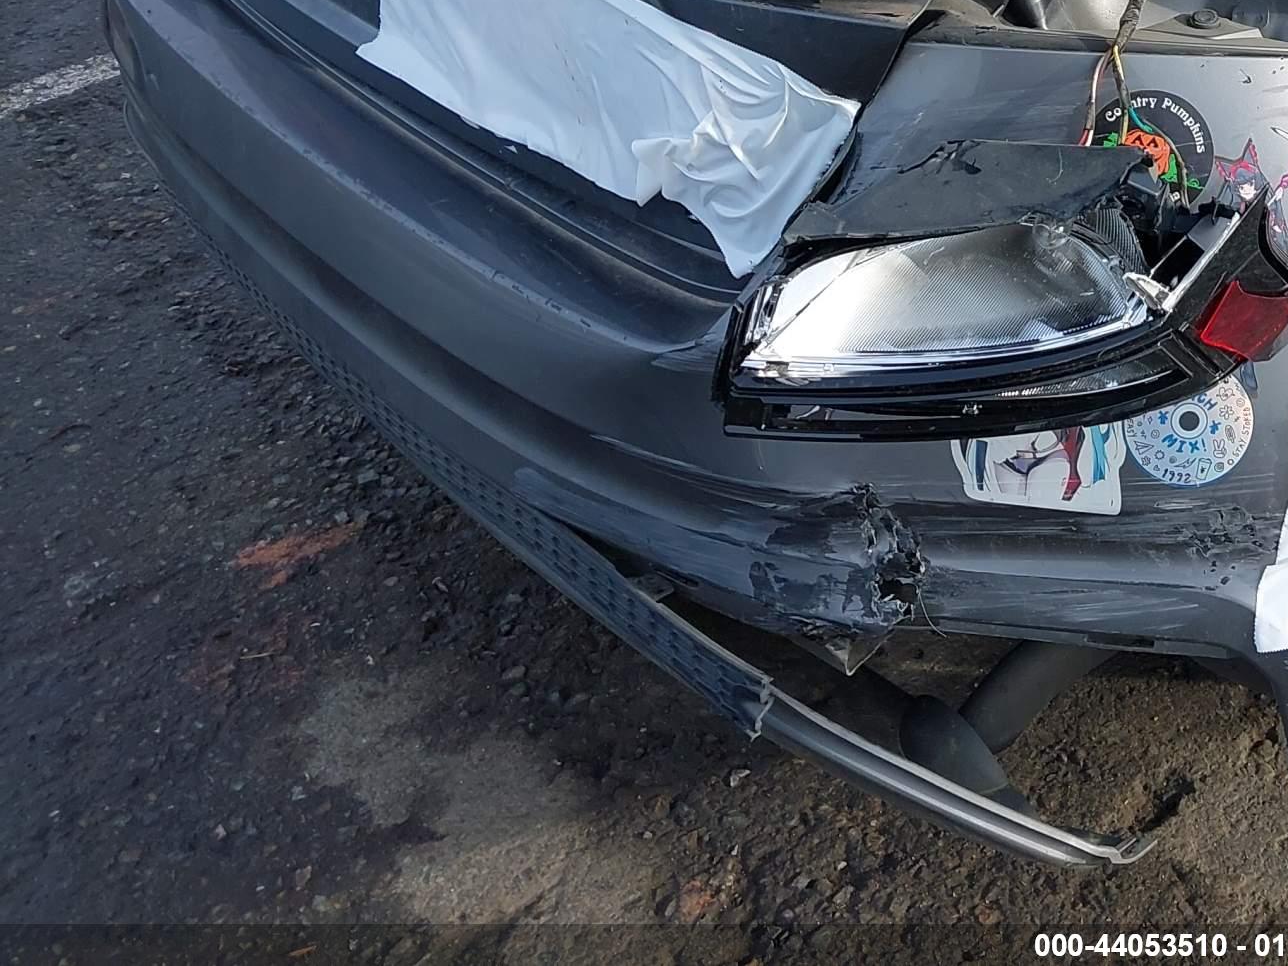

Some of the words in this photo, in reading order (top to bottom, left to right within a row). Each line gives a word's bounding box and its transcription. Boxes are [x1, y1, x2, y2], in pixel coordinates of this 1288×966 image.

[1104, 96, 1158, 122] Contry
[1161, 96, 1207, 155] Pumpkins
[1161, 433, 1208, 454] MIX!
[1232, 437, 1247, 458] STAY
[1162, 468, 1192, 484] 1992
